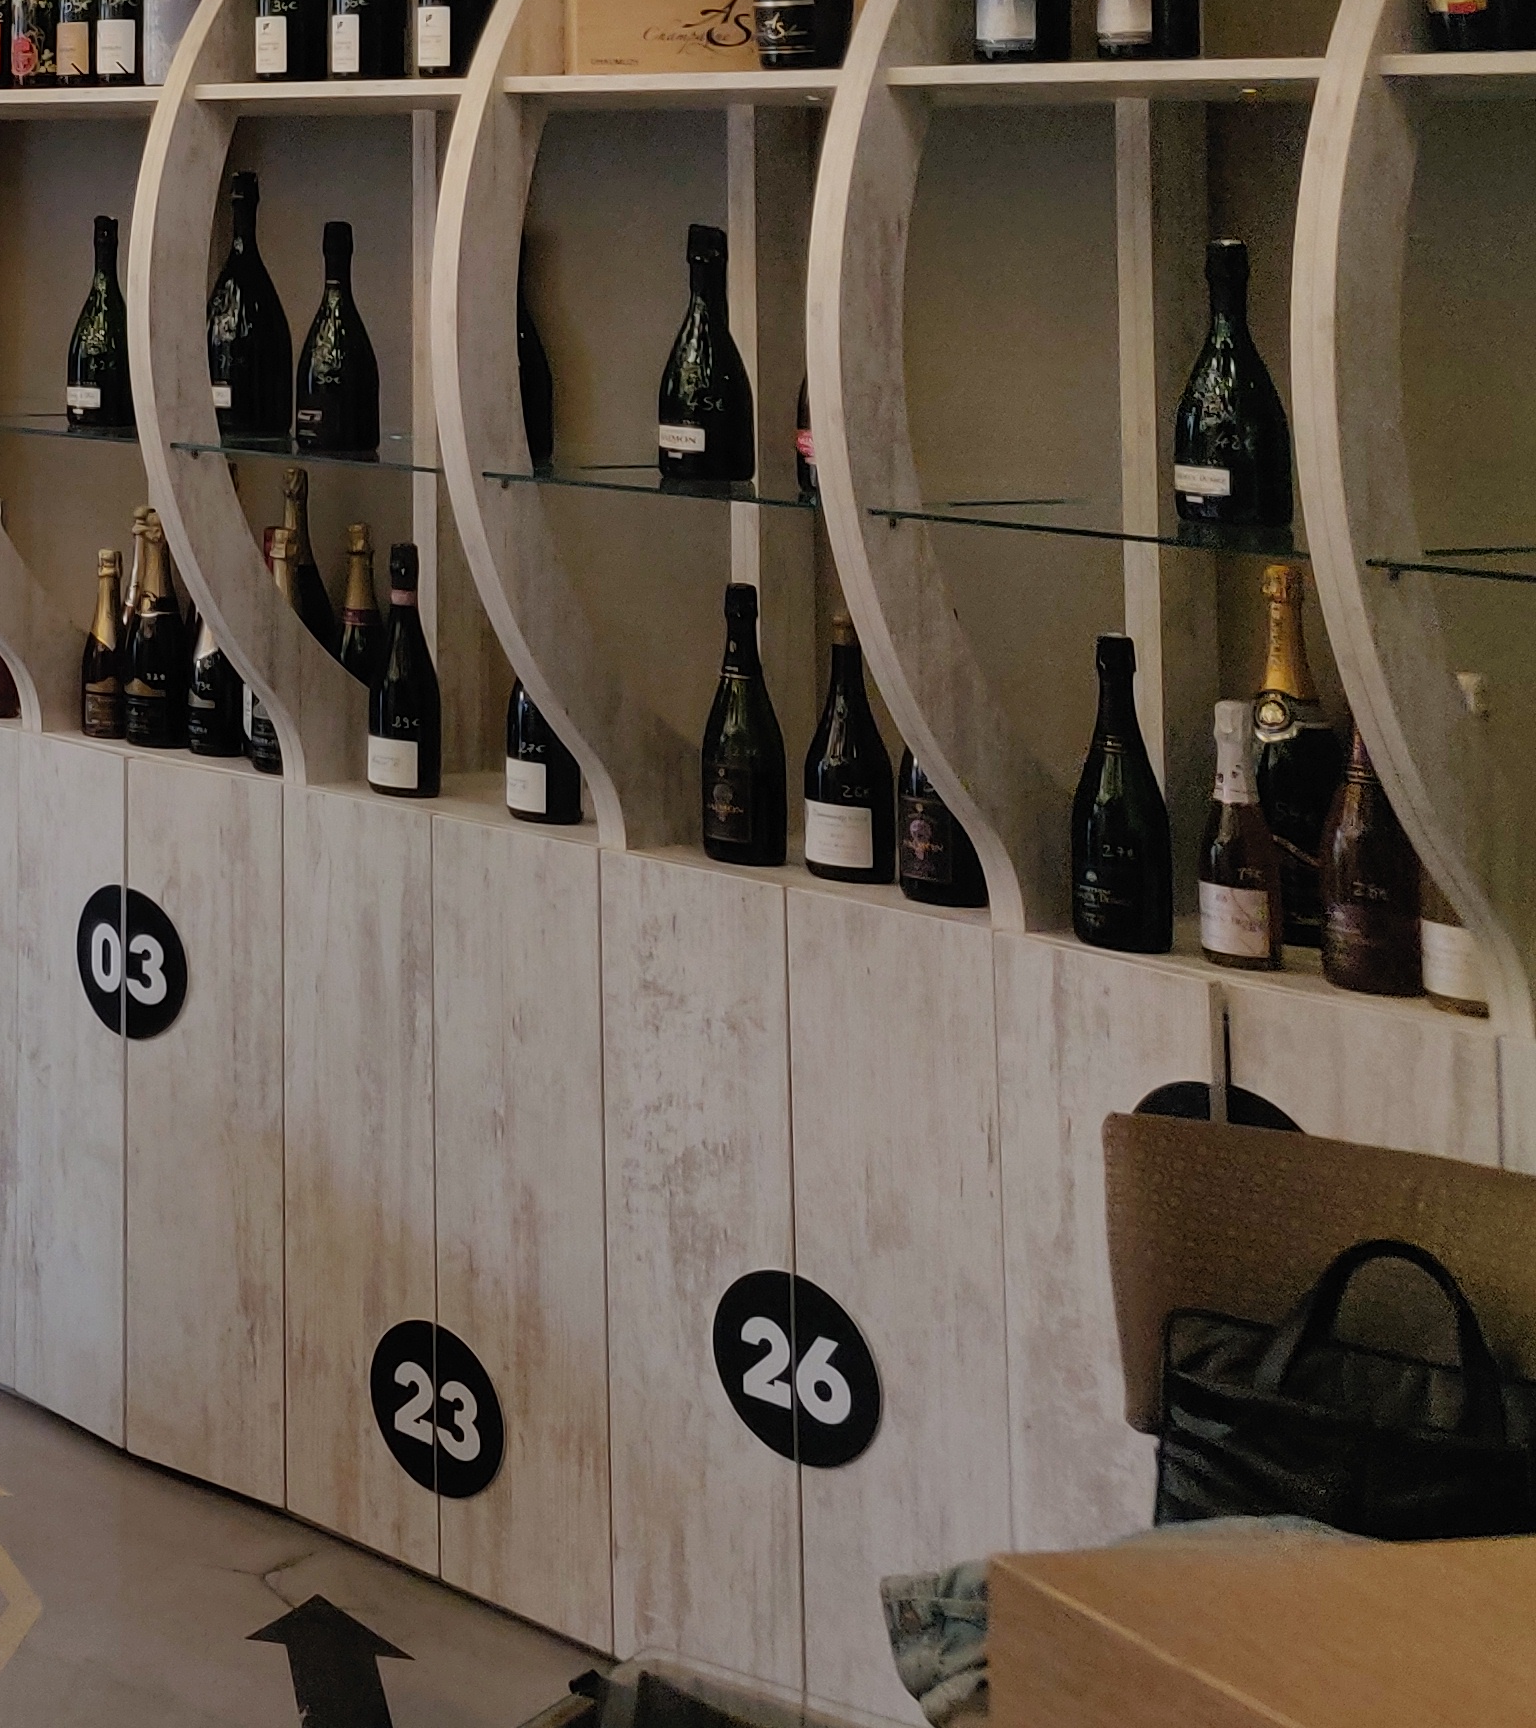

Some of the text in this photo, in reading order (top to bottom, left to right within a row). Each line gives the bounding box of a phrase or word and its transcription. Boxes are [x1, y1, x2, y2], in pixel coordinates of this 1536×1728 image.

[90, 921, 168, 1006] 03
[393, 1360, 482, 1462] 23
[740, 1315, 853, 1427] 26
